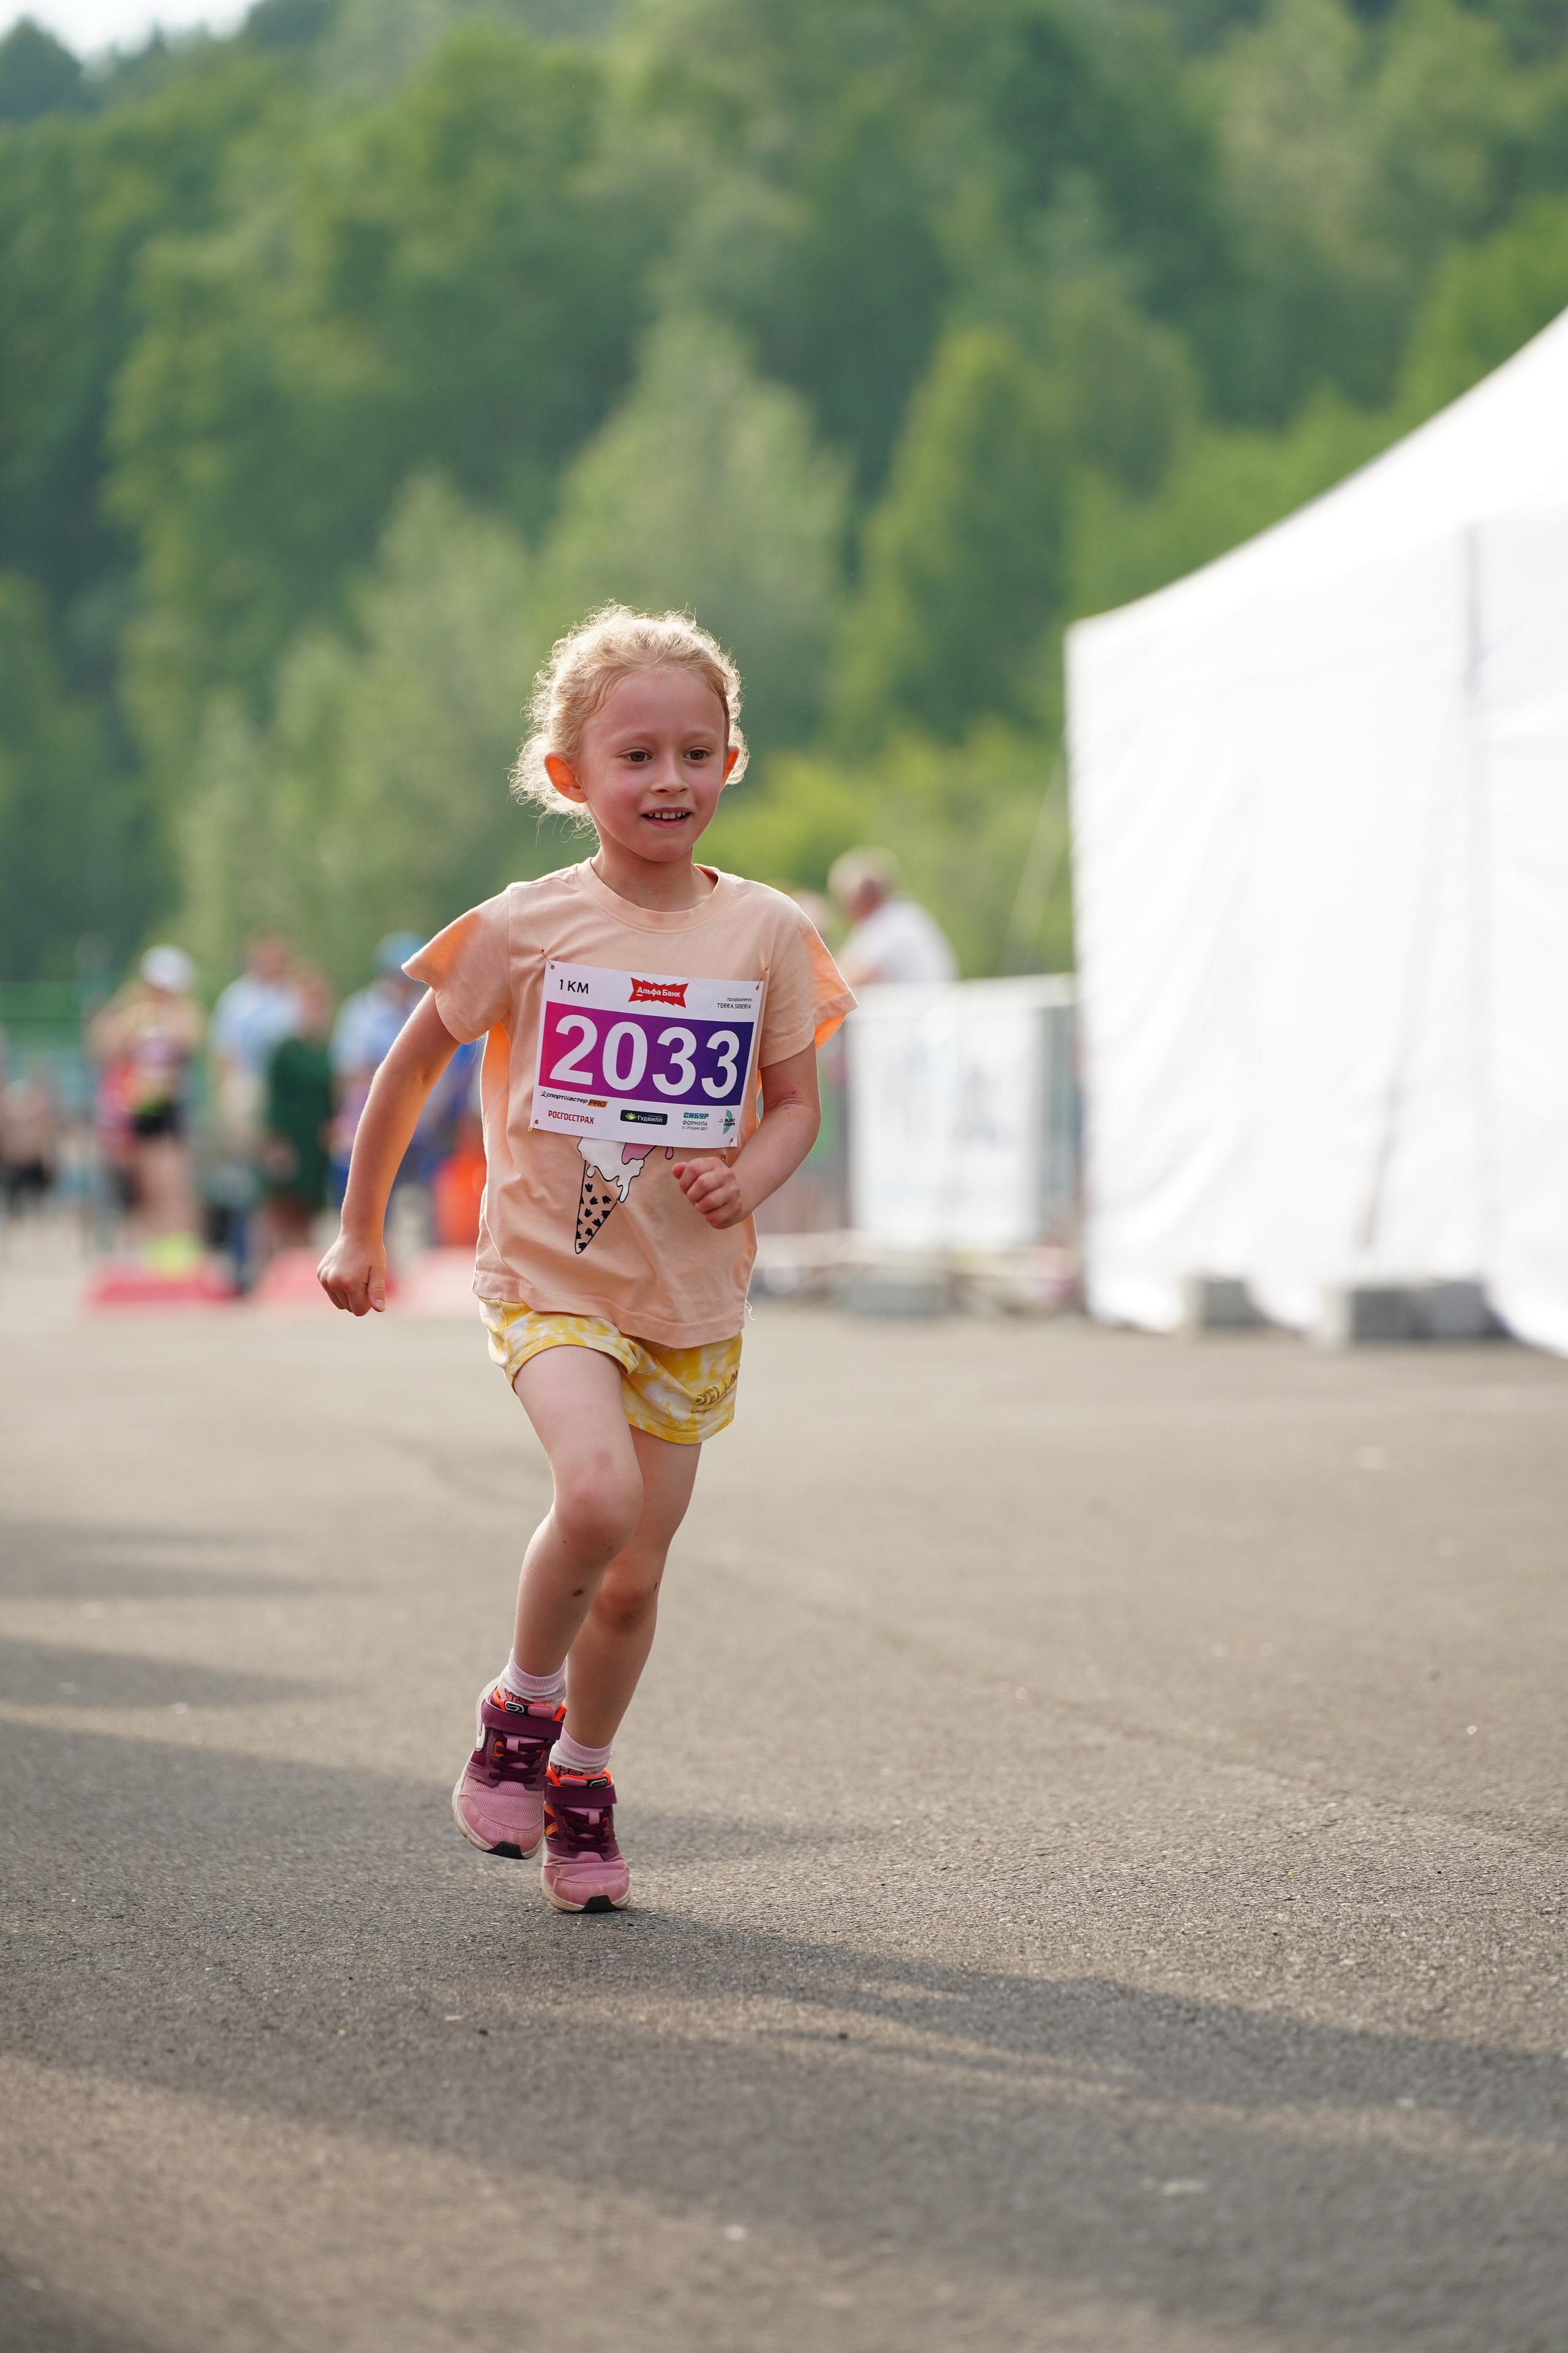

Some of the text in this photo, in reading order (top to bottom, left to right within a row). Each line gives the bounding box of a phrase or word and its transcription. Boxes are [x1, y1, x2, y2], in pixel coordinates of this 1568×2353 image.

[560, 979, 563, 990] 1
[636, 986, 681, 998] Альфа Банк
[549, 1014, 740, 1098] 2033
[548, 1110, 594, 1124] РОСГОССТРАХ
